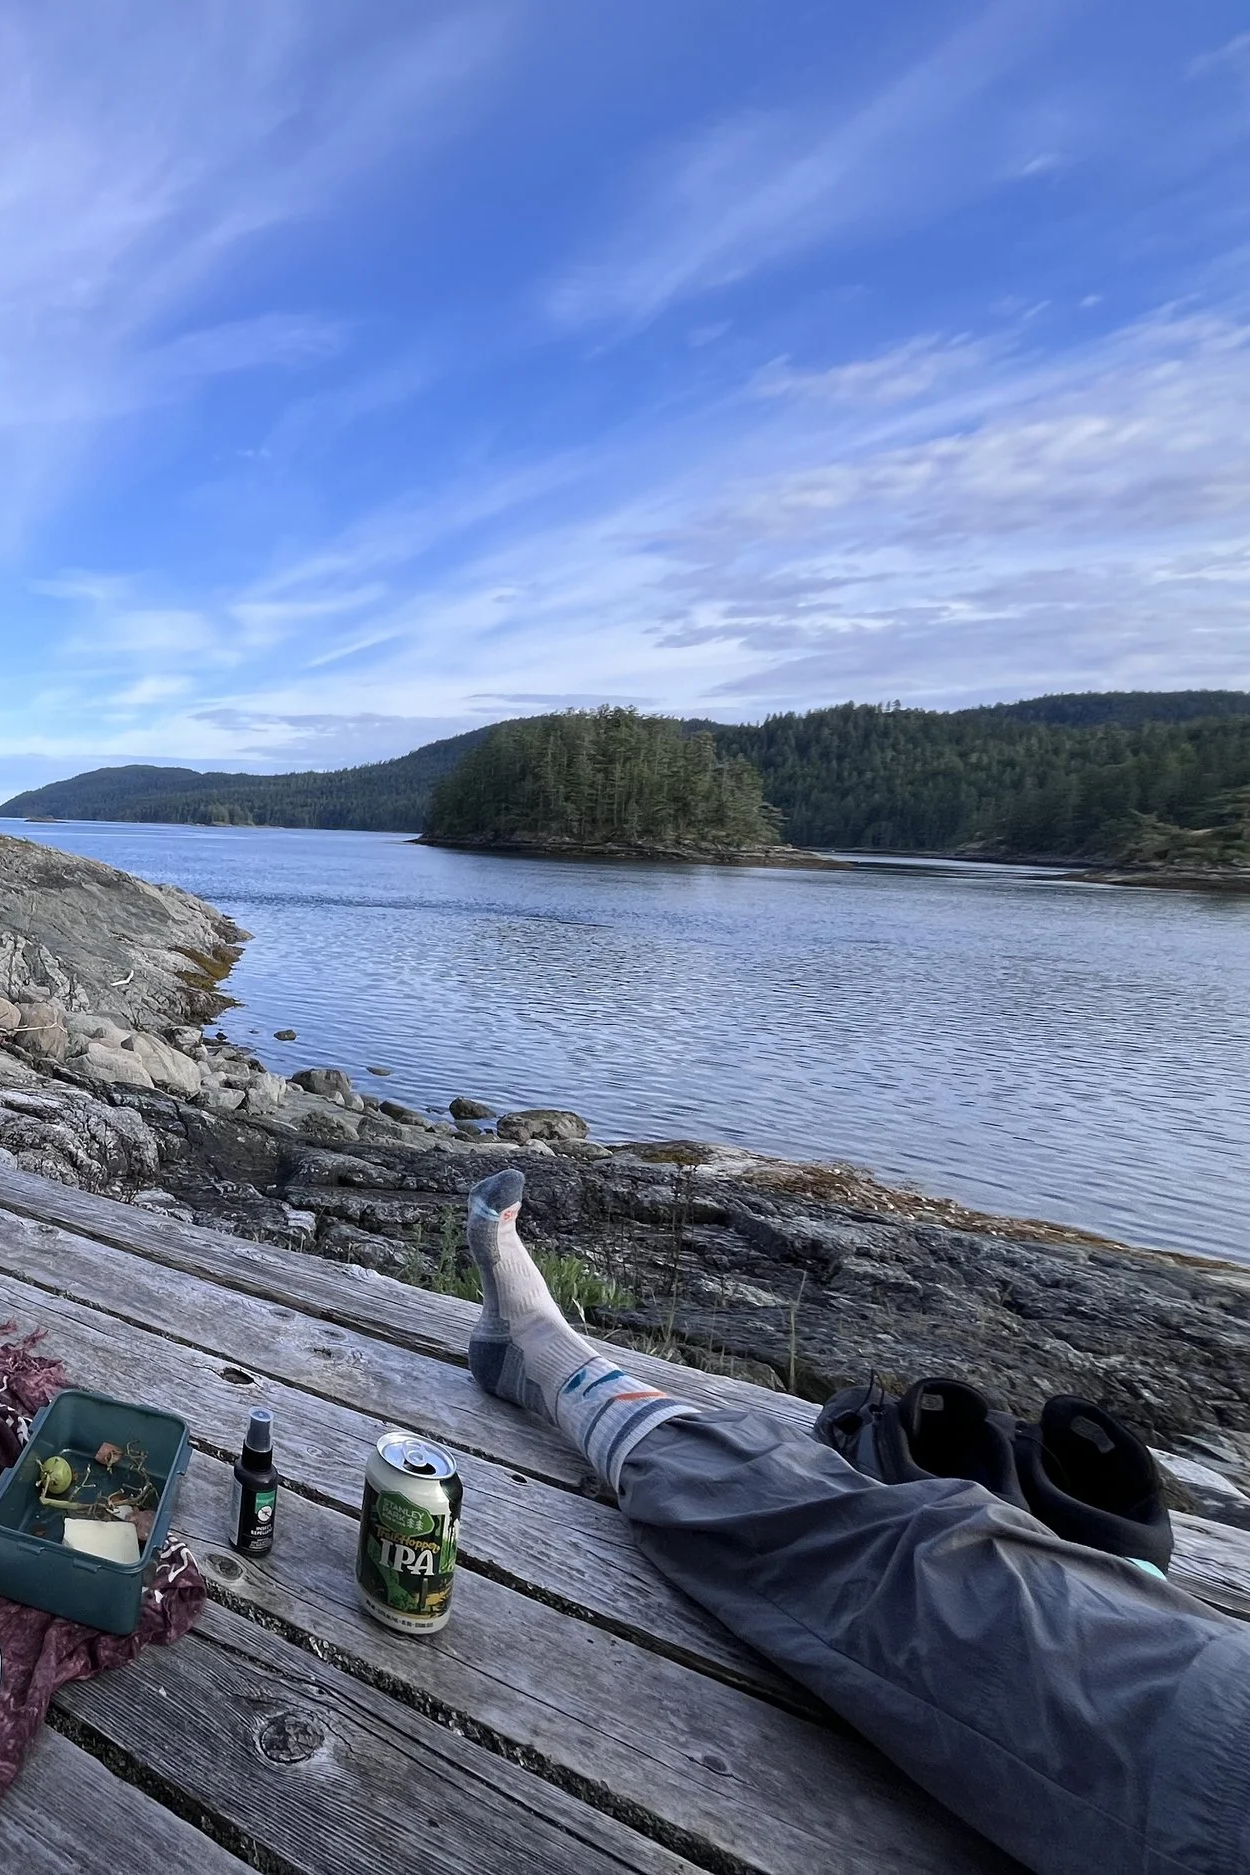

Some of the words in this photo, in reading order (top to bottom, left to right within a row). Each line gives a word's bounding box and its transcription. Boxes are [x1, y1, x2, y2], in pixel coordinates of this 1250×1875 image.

[382, 1498, 425, 1519] STANLEY
[382, 1505, 406, 1521] PARK
[379, 1538, 435, 1576] IPA
